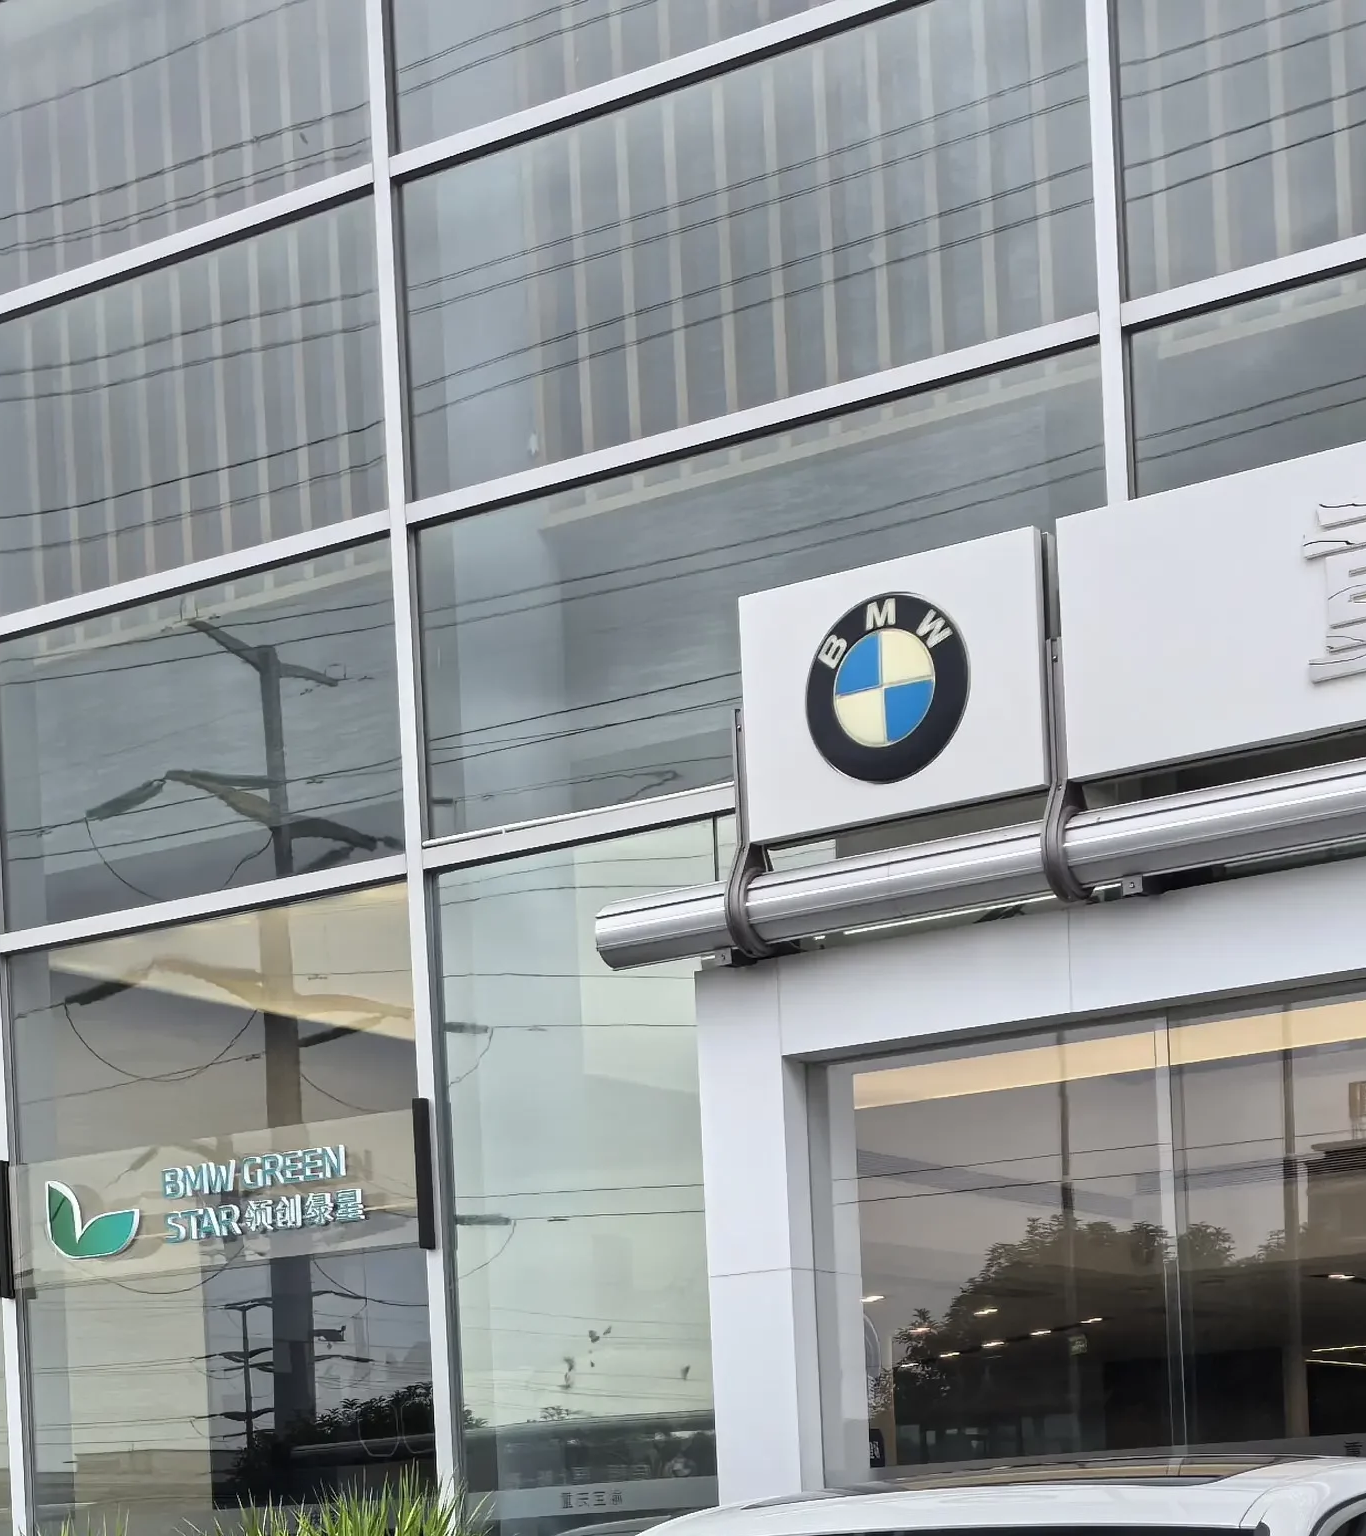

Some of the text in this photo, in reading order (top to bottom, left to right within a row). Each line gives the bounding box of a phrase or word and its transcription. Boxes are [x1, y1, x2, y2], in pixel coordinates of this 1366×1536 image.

[817, 597, 953, 669] BMW
[161, 1144, 348, 1200] BMW GREEN
[165, 1188, 367, 1244] STAR 领创绿星
